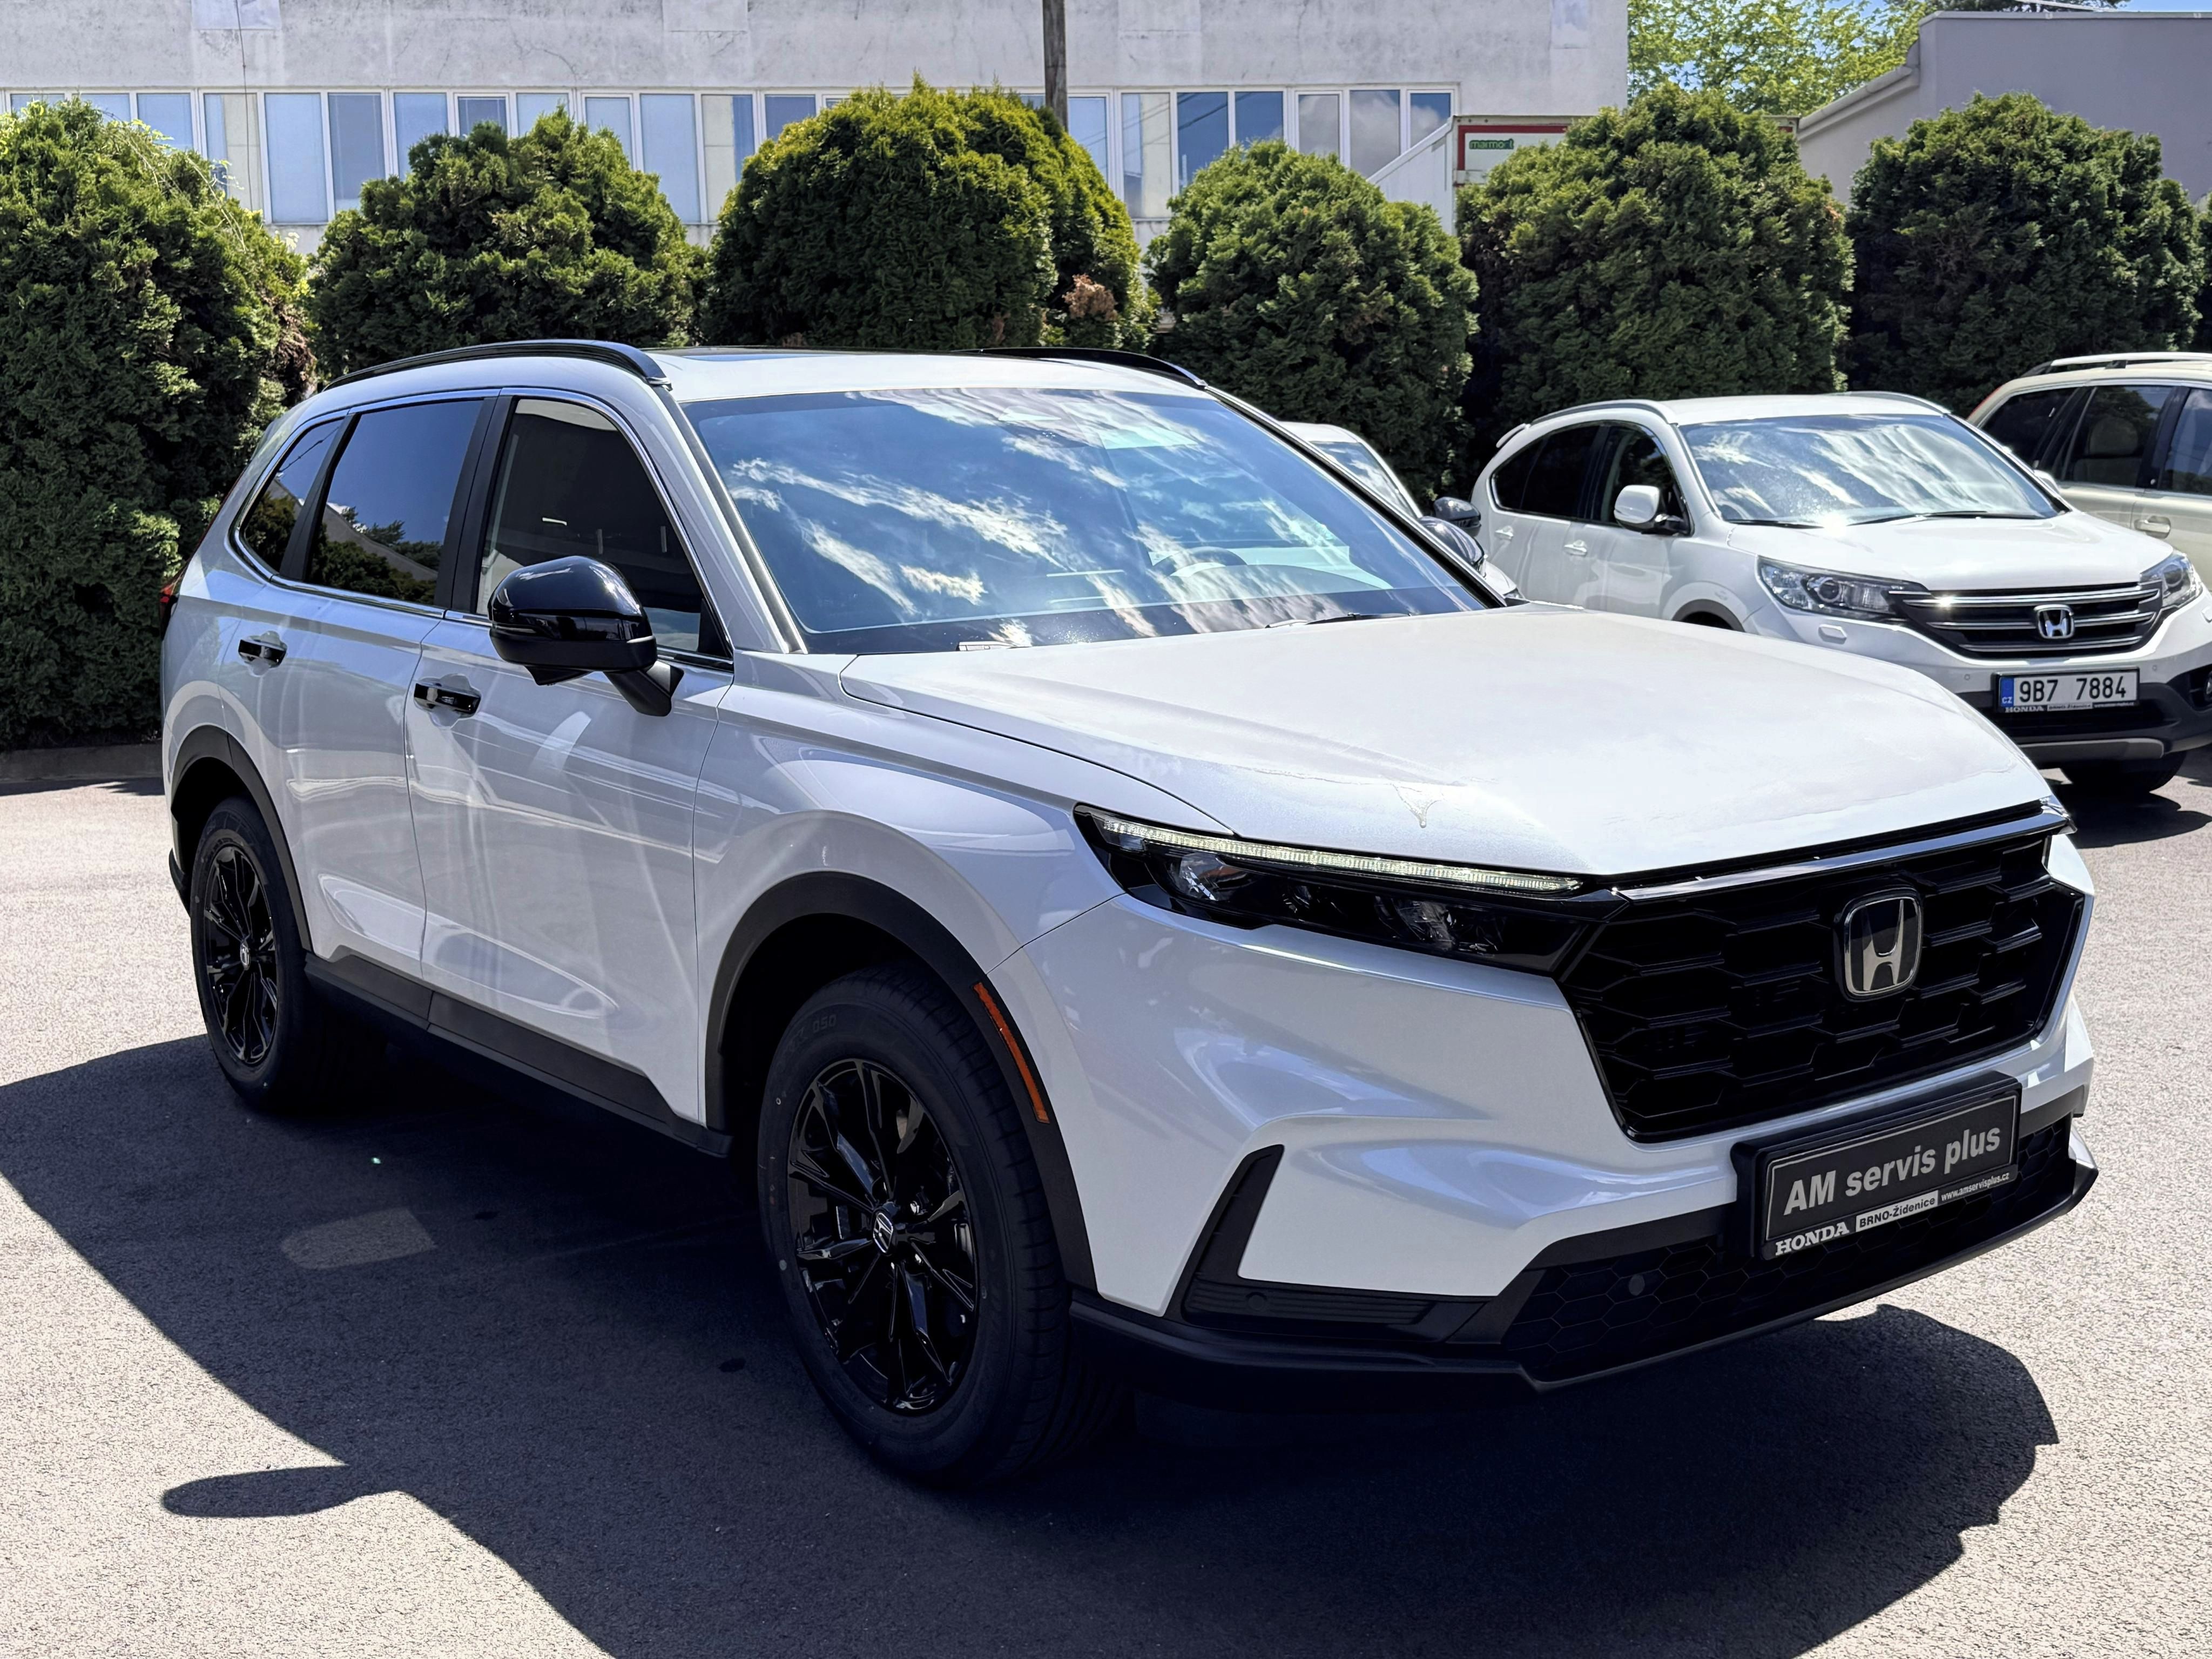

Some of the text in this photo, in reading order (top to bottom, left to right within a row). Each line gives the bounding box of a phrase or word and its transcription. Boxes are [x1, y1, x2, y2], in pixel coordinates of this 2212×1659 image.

[2001, 696, 2013, 704] CZ
[2019, 676, 2127, 702] 9B7 7884
[2005, 705, 2044, 713] HONDA
[1783, 1127, 2000, 1216] AM servis plus
[1775, 1172, 2009, 1256] HONDA BRNO-Židenice www.amservisplus.cz
